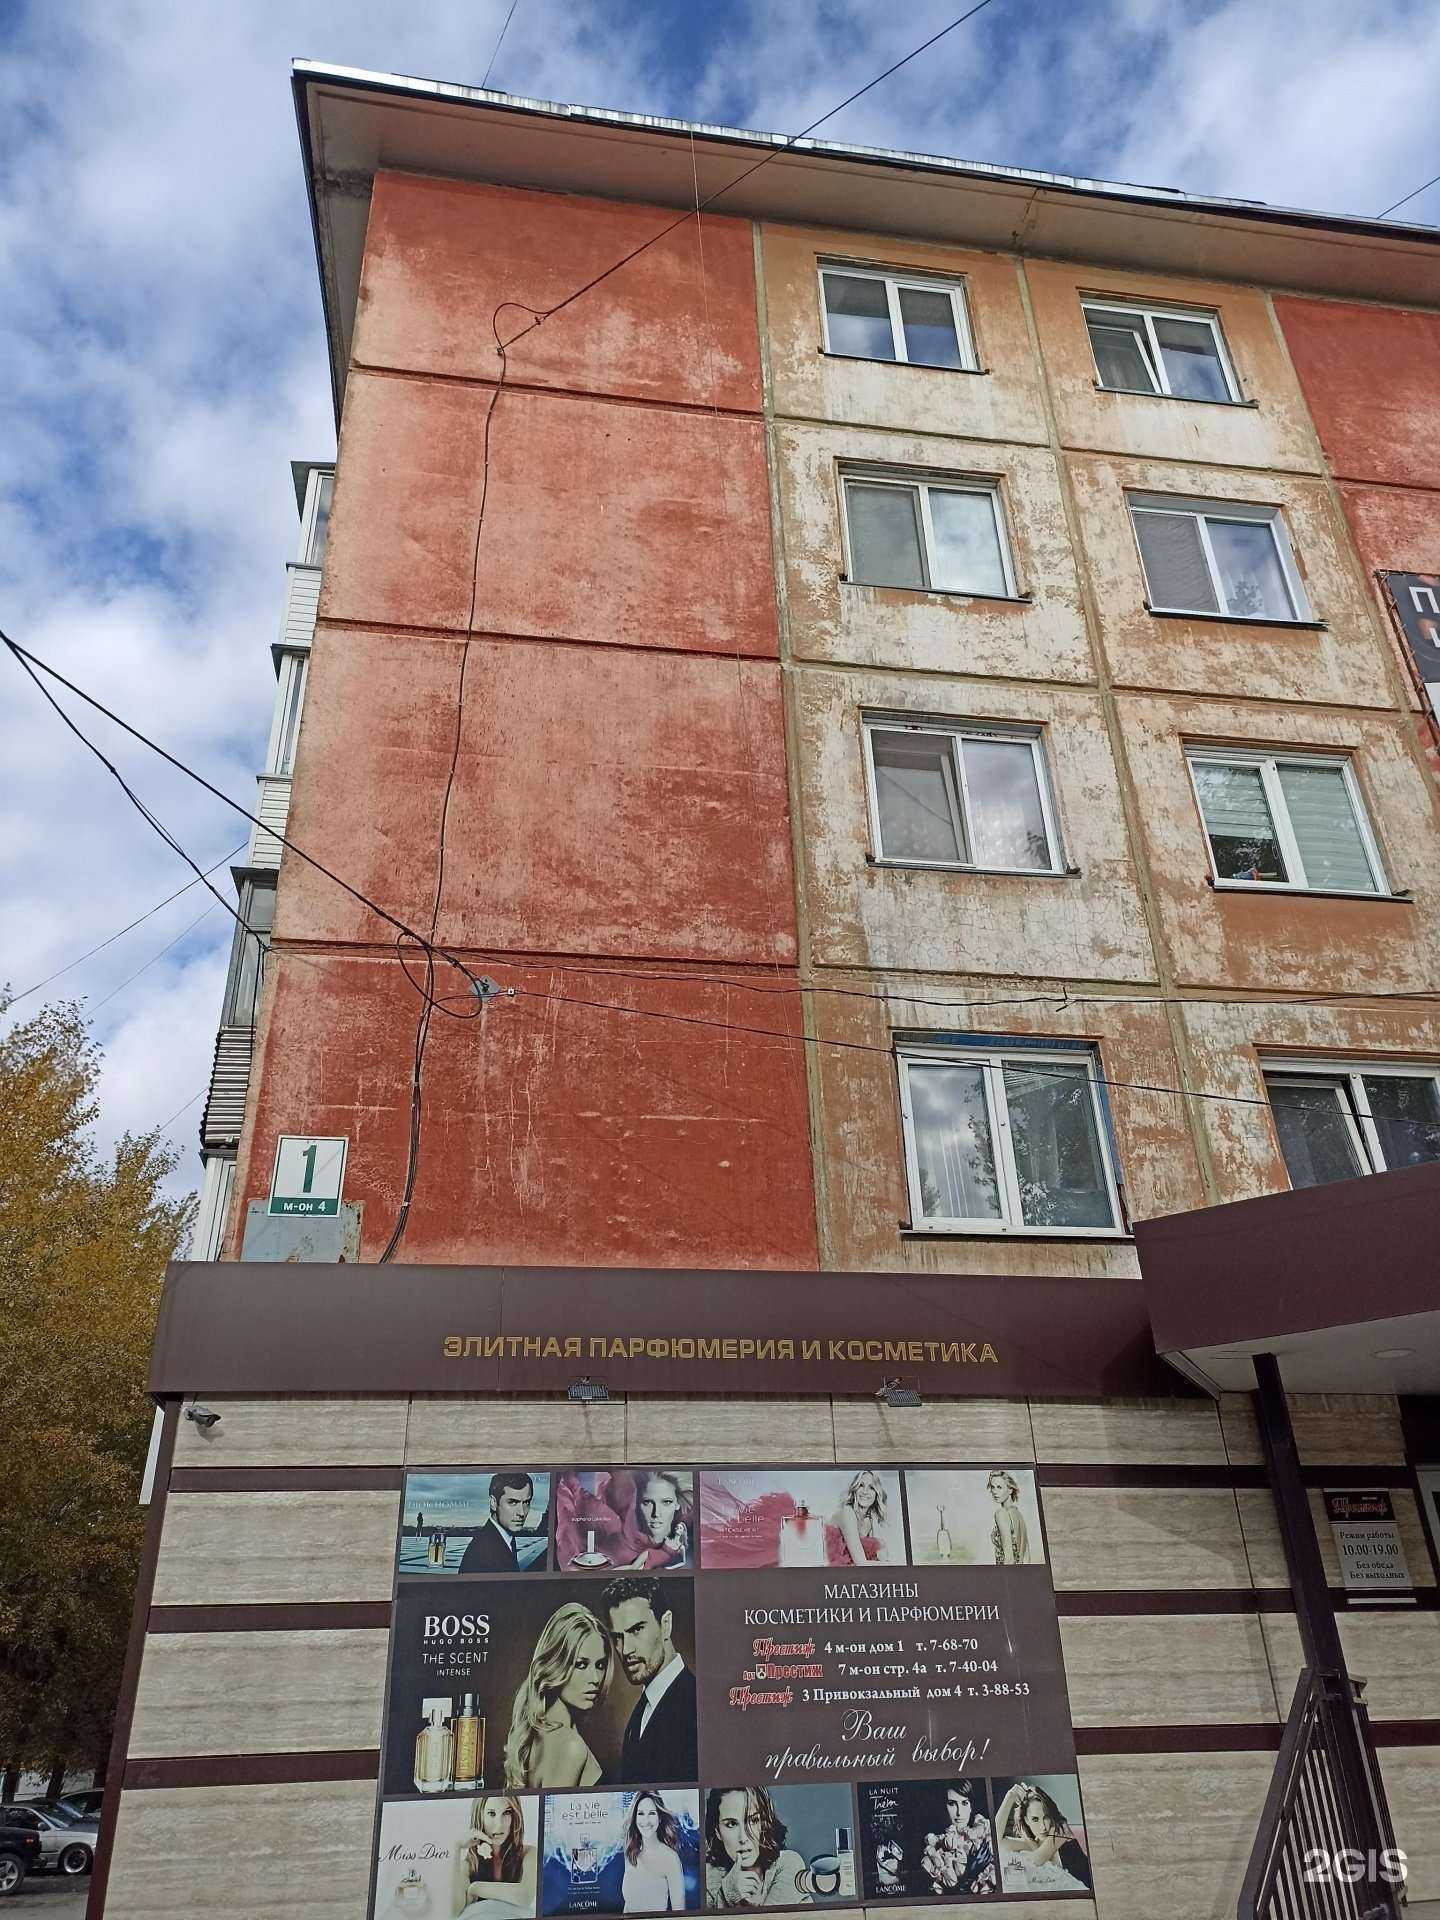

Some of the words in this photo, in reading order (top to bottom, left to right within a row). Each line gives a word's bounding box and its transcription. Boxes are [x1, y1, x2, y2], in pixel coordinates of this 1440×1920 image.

[302, 1144, 317, 1193] 1
[318, 1201, 326, 1212] 4
[443, 1336, 582, 1358] ЭЛИТНАЯ
[589, 1338, 795, 1360] ПАРФЮМЕРИЯ
[802, 1341, 821, 1359] И
[829, 1340, 999, 1363] КОСМЕТИКА
[1342, 1544, 1399, 1556] 10.00-19.00
[824, 1583, 919, 1600] МАГАЗИНЫ
[744, 1607, 854, 1625] КОСМЕТИКИ
[859, 1607, 871, 1623] И
[876, 1604, 1000, 1623] ПАРФЮМЕРИИ
[424, 1614, 490, 1637] BOSS
[824, 1641, 833, 1654] 4
[835, 1643, 866, 1654] м-он
[869, 1643, 894, 1655] дом
[897, 1640, 904, 1653] 1
[916, 1641, 927, 1652] т.
[929, 1638, 978, 1651] 7-68-70
[422, 1653, 445, 1665] THE
[449, 1651, 489, 1664] SCENT
[436, 1667, 472, 1677] INTENSE
[766, 1663, 824, 1680] Престиж
[838, 1664, 846, 1676] 7
[849, 1665, 880, 1676] м-он
[884, 1664, 909, 1679] стр.
[912, 1662, 927, 1675] 4а
[936, 1663, 947, 1674] т.
[949, 1660, 999, 1674] 7-40-04
[802, 1690, 810, 1702] 3
[813, 1686, 920, 1704] Привокзальный
[926, 1687, 950, 1700] дом
[953, 1685, 962, 1697] 4
[967, 1685, 979, 1696] т.
[981, 1683, 1030, 1697] 3-88-53
[841, 1708, 907, 1742] Ваш
[765, 1744, 897, 1779] правильный
[912, 1735, 991, 1772] выбор!
[880, 1787, 898, 1795] NUIT
[418, 1842, 450, 1860] Dior
